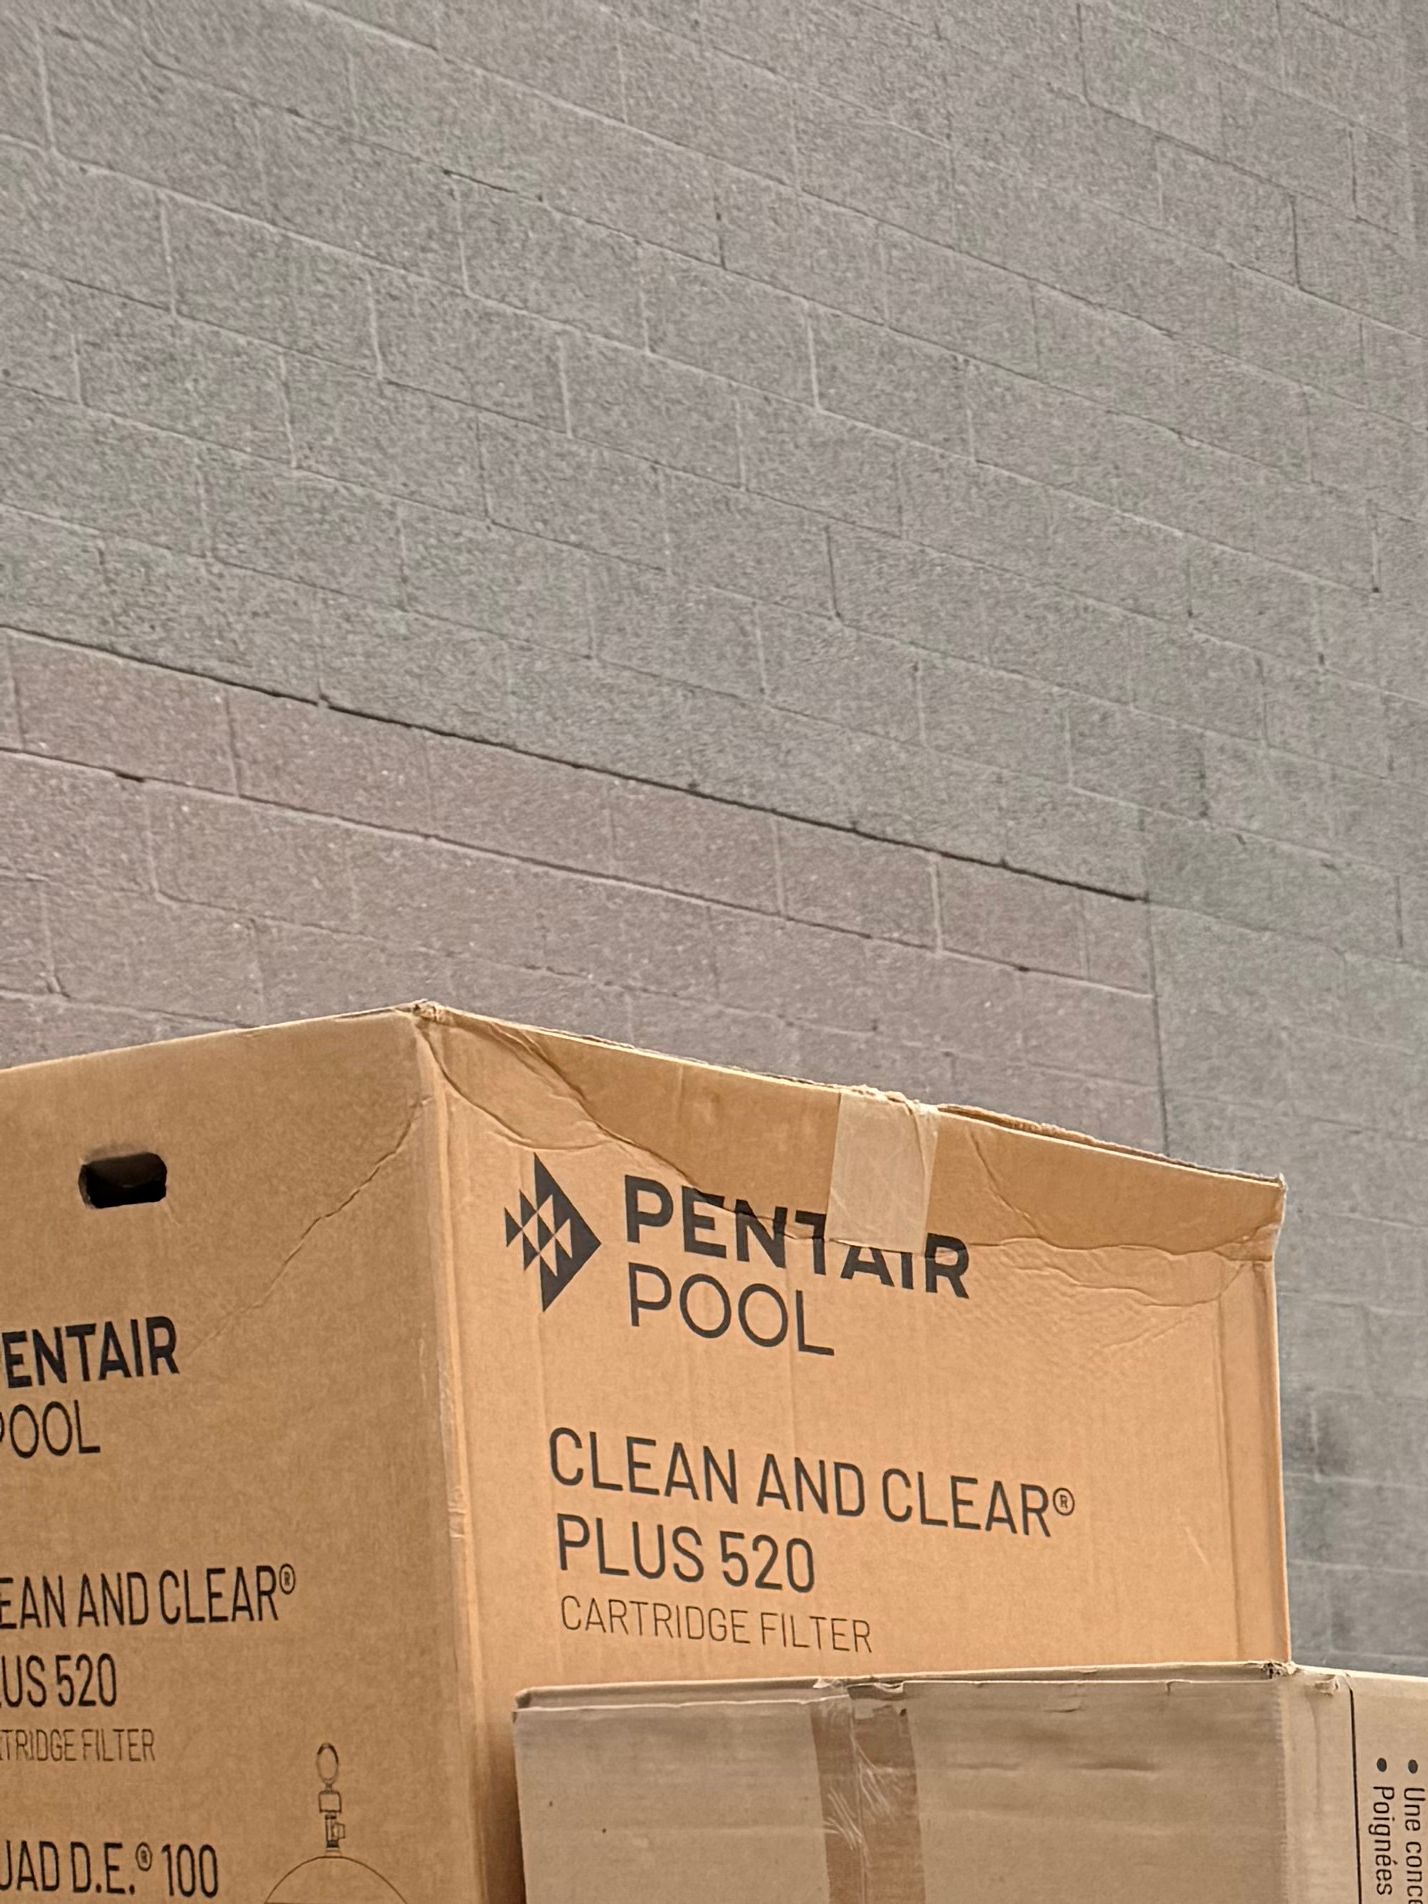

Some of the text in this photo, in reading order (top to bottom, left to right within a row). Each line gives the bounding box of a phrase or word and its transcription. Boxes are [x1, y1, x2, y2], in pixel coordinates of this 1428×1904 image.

[628, 1262, 834, 1356] POOL
[2, 1316, 179, 1388] ENTAIR
[550, 1427, 738, 1504] CLEAN
[757, 1454, 865, 1516] AND
[557, 1513, 814, 1593] PLUS 520
[0, 1575, 66, 1629] EAN
[78, 1572, 148, 1627] AND
[561, 1595, 872, 1653] CARTRIDGE FILTER
[0, 1653, 116, 1708] US 520
[0, 1729, 155, 1762] TRIDGE FILTER
[1404, 1788, 1426, 1831] Une
[0, 1840, 60, 1891] UAD
[162, 1844, 218, 1898] 100
[1368, 1787, 1397, 1895] Poignées
